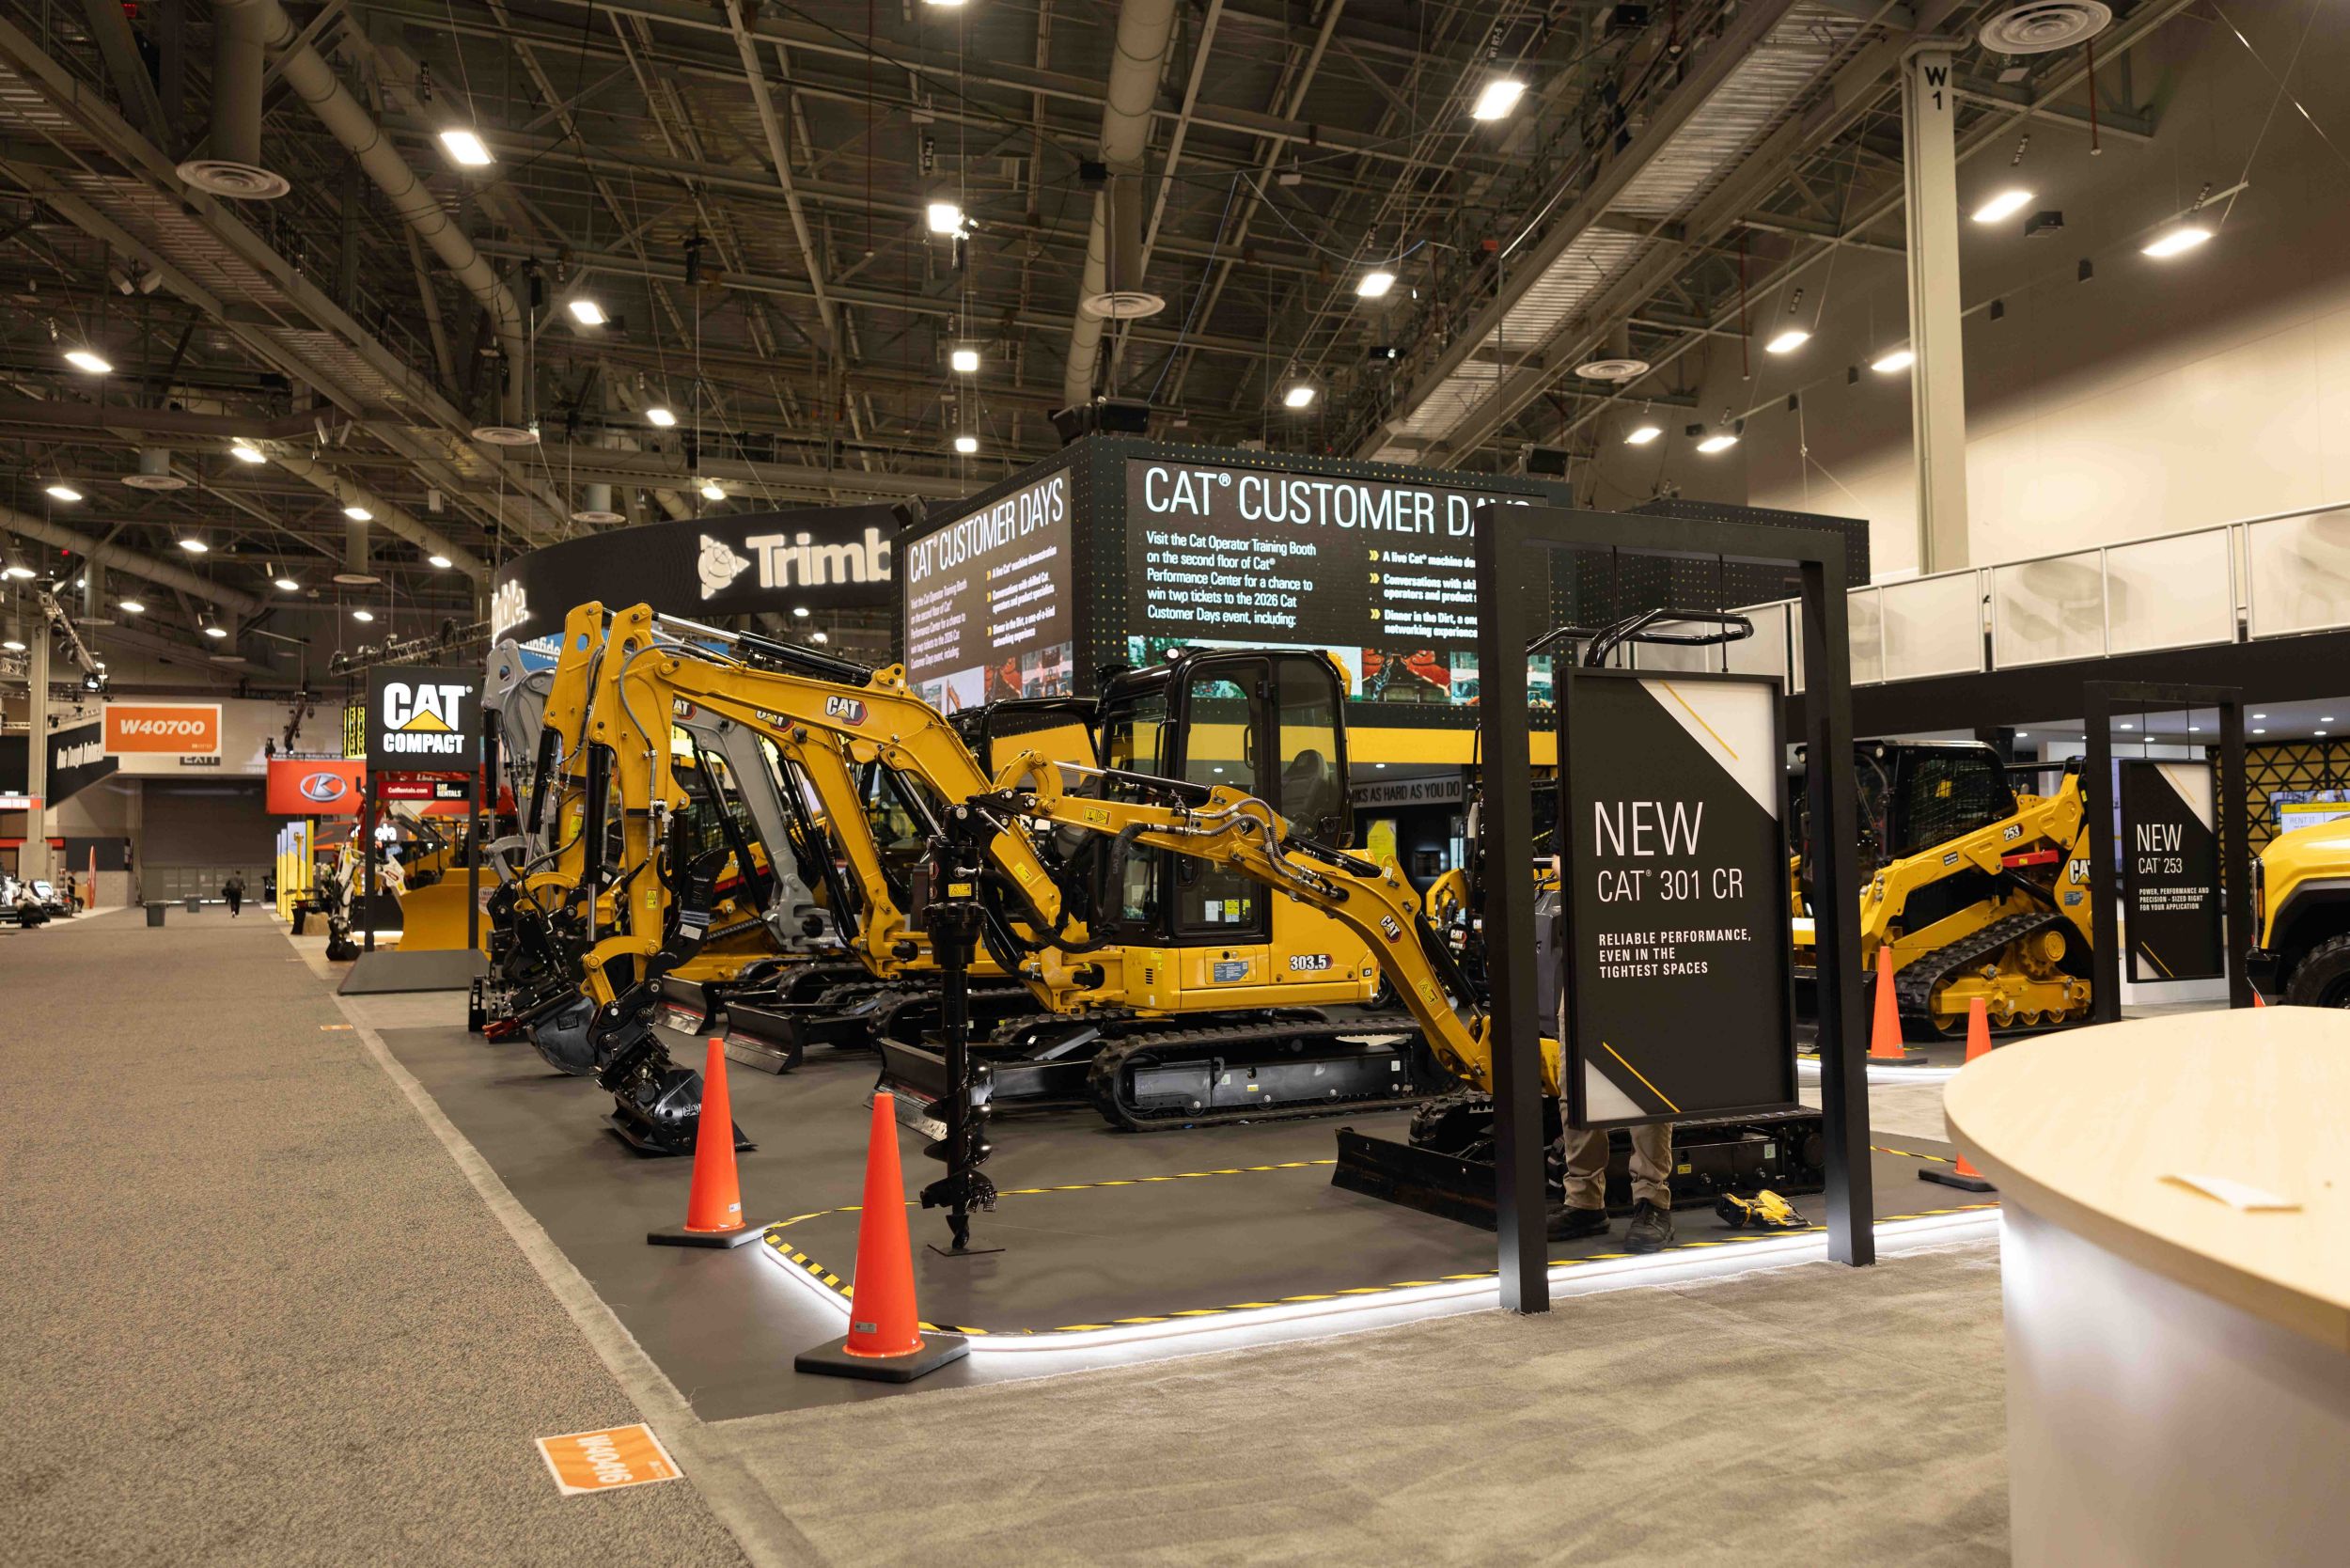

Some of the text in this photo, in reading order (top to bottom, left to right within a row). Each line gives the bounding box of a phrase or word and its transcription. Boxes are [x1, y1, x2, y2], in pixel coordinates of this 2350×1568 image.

[1924, 66, 1948, 86] W
[1933, 90, 1942, 110] 1
[1239, 476, 1435, 534] CUSTOMER
[940, 500, 1015, 571] CUSTOMER
[1020, 478, 1063, 536] DAYS
[1146, 530, 1316, 557] Visit the Cat Operator Training Booth
[745, 527, 891, 588] Trimb
[1147, 552, 1160, 563] on
[1162, 551, 1178, 564] the
[1181, 554, 1214, 567] second
[1217, 555, 1239, 568] floor
[1241, 557, 1251, 569] of
[1383, 551, 1390, 561] A
[1147, 568, 1312, 591] Performance Center for a chance to
[1147, 588, 1166, 600] win
[1191, 588, 1222, 604] tickets
[1224, 592, 1235, 604] to
[1236, 591, 1253, 605] the
[1254, 593, 1278, 606] 2026
[1280, 594, 1297, 608] Cat
[1148, 604, 1296, 628] Customer Days event, including:
[673, 698, 690, 715] AT
[826, 696, 860, 720] CAT
[120, 719, 206, 735] W40700
[383, 732, 465, 754] COMPACT
[1383, 785, 1408, 801] HARD
[1410, 783, 1422, 799] AS
[1424, 782, 1444, 798] YOU
[1447, 781, 1460, 796] DO
[1595, 801, 1703, 856] NEW
[2003, 825, 2020, 841] 253
[2137, 824, 2182, 852] NEW
[2069, 859, 2091, 885] CA
[2164, 857, 2183, 873] 253
[1660, 870, 1700, 901] 301
[1713, 868, 1743, 900] CR
[1380, 915, 1401, 938] CAT
[1450, 929, 1464, 940] CAT
[1599, 928, 1751, 946] RELIABLE PERFORMANCE,
[1290, 955, 1327, 970] 303.5
[1599, 947, 1676, 963] EVEN IN THE
[1600, 962, 1708, 979] TIGHTEST SPACES
